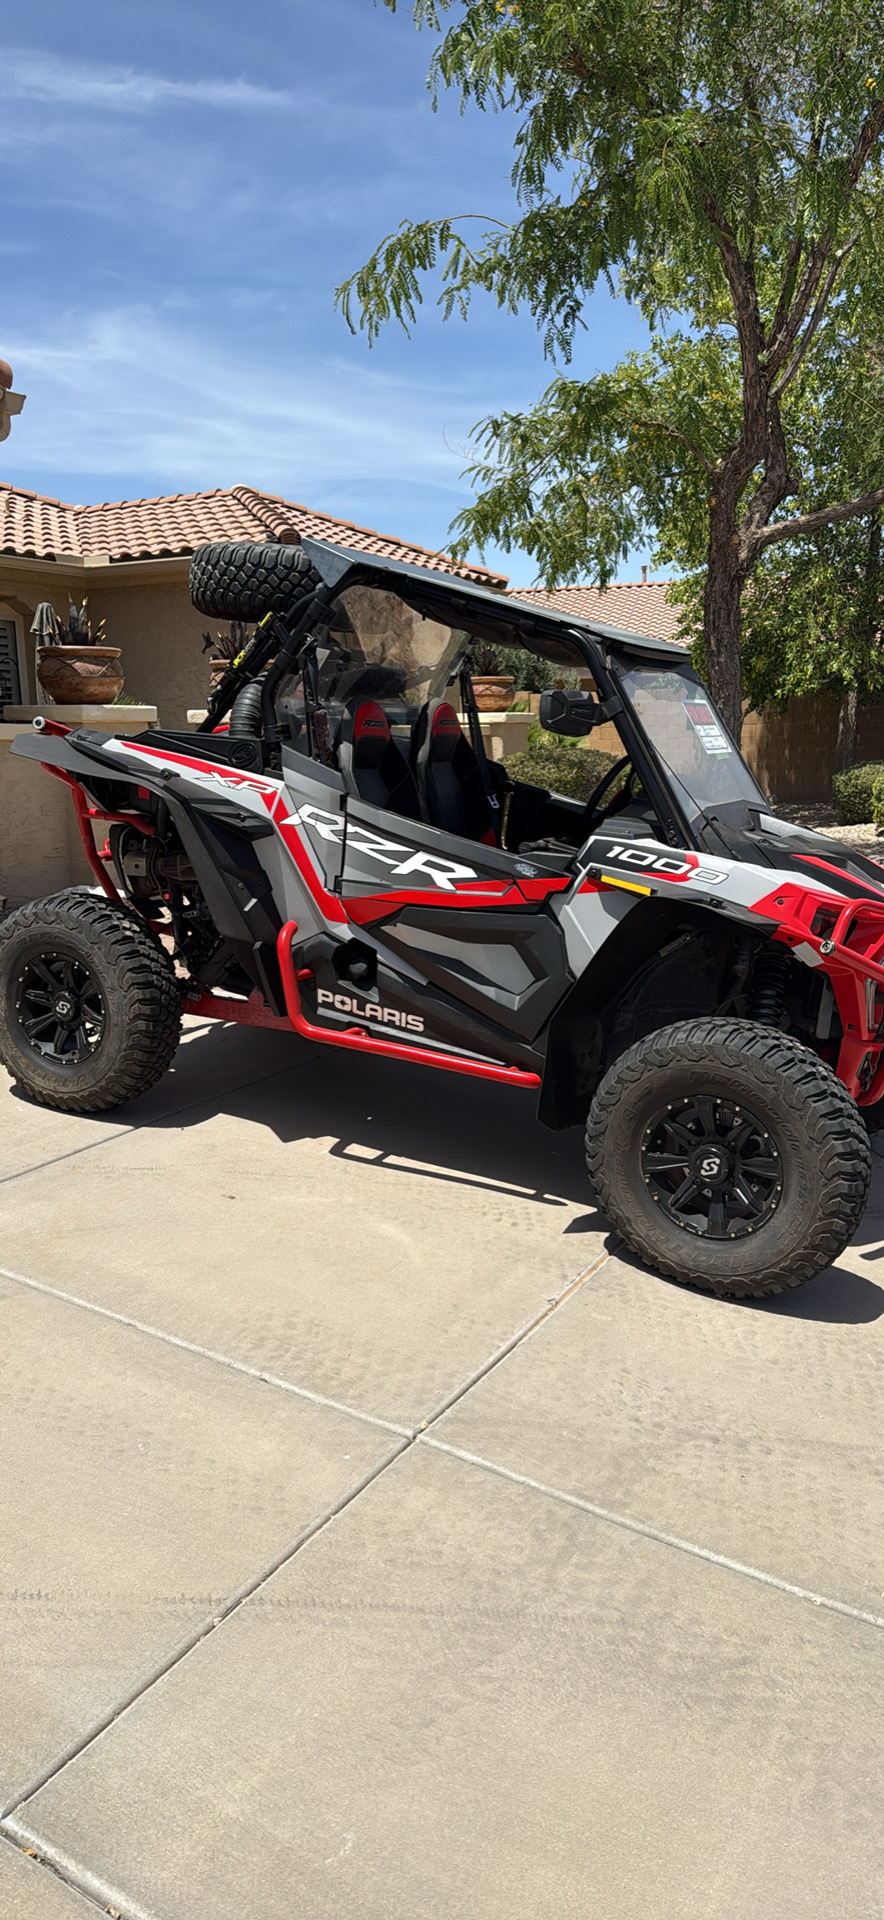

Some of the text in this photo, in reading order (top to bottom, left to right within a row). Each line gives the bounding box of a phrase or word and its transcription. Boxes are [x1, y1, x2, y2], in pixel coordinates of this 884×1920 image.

[362, 719, 385, 728] RZR
[195, 771, 278, 795] XP
[279, 803, 478, 891] RZR
[606, 845, 729, 885] 1000
[317, 988, 425, 1032] POLARIS
